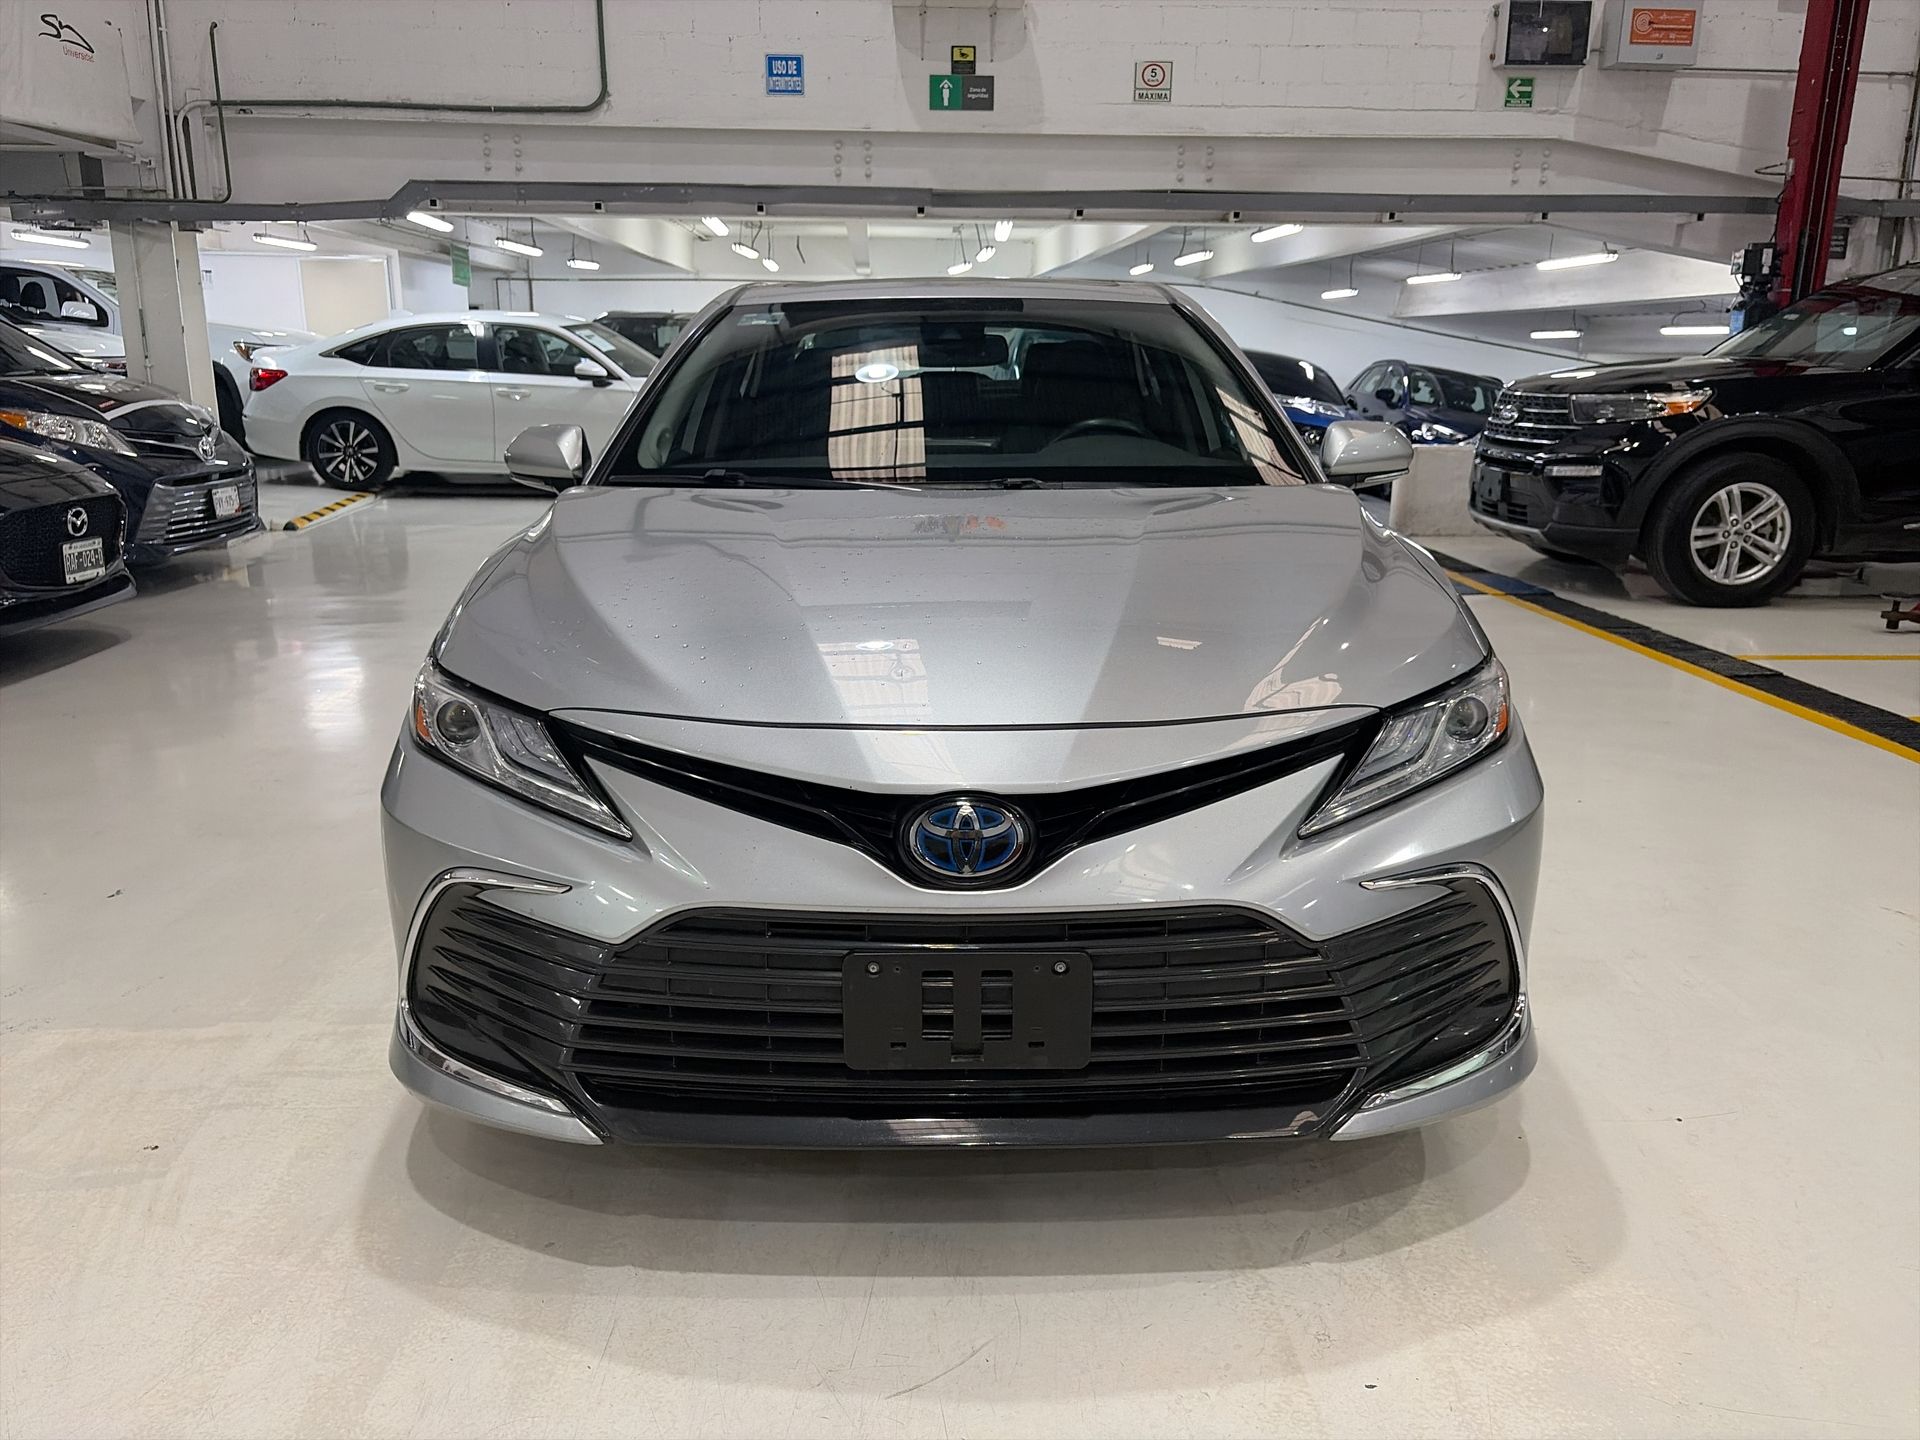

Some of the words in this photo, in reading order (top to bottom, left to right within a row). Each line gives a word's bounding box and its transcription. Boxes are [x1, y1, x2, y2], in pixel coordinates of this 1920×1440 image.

[772, 60, 787, 75] USO
[788, 60, 798, 75] DE
[1150, 68, 1158, 78] 5
